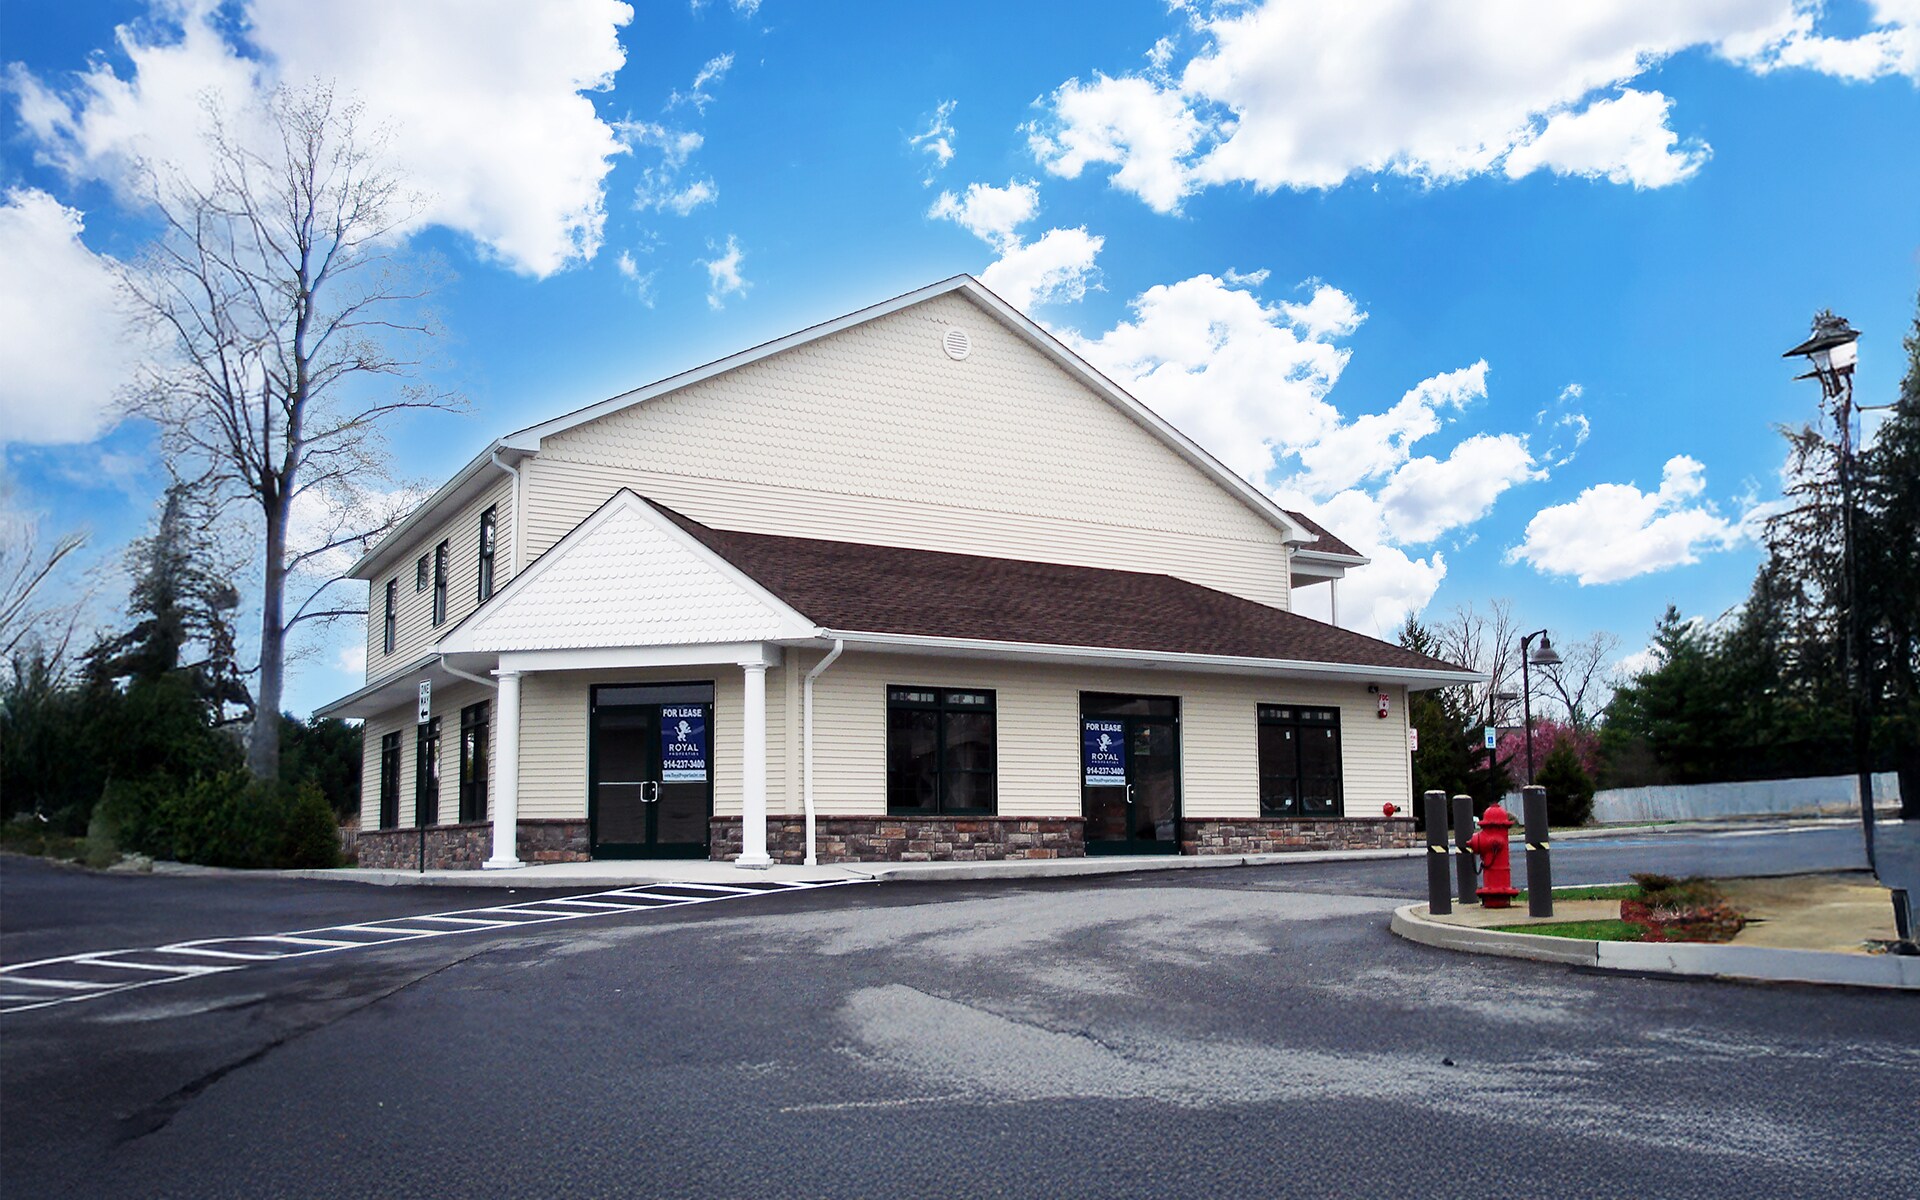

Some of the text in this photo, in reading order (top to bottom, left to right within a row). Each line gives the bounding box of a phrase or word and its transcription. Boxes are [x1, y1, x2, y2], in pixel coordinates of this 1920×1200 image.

[663, 708, 702, 717] FOR LEASE
[1086, 722, 1122, 732] FOR LEASE
[669, 743, 699, 752] ROYAL
[663, 760, 705, 769] 914-237-3400
[1086, 767, 1125, 775] 914-237-3400
